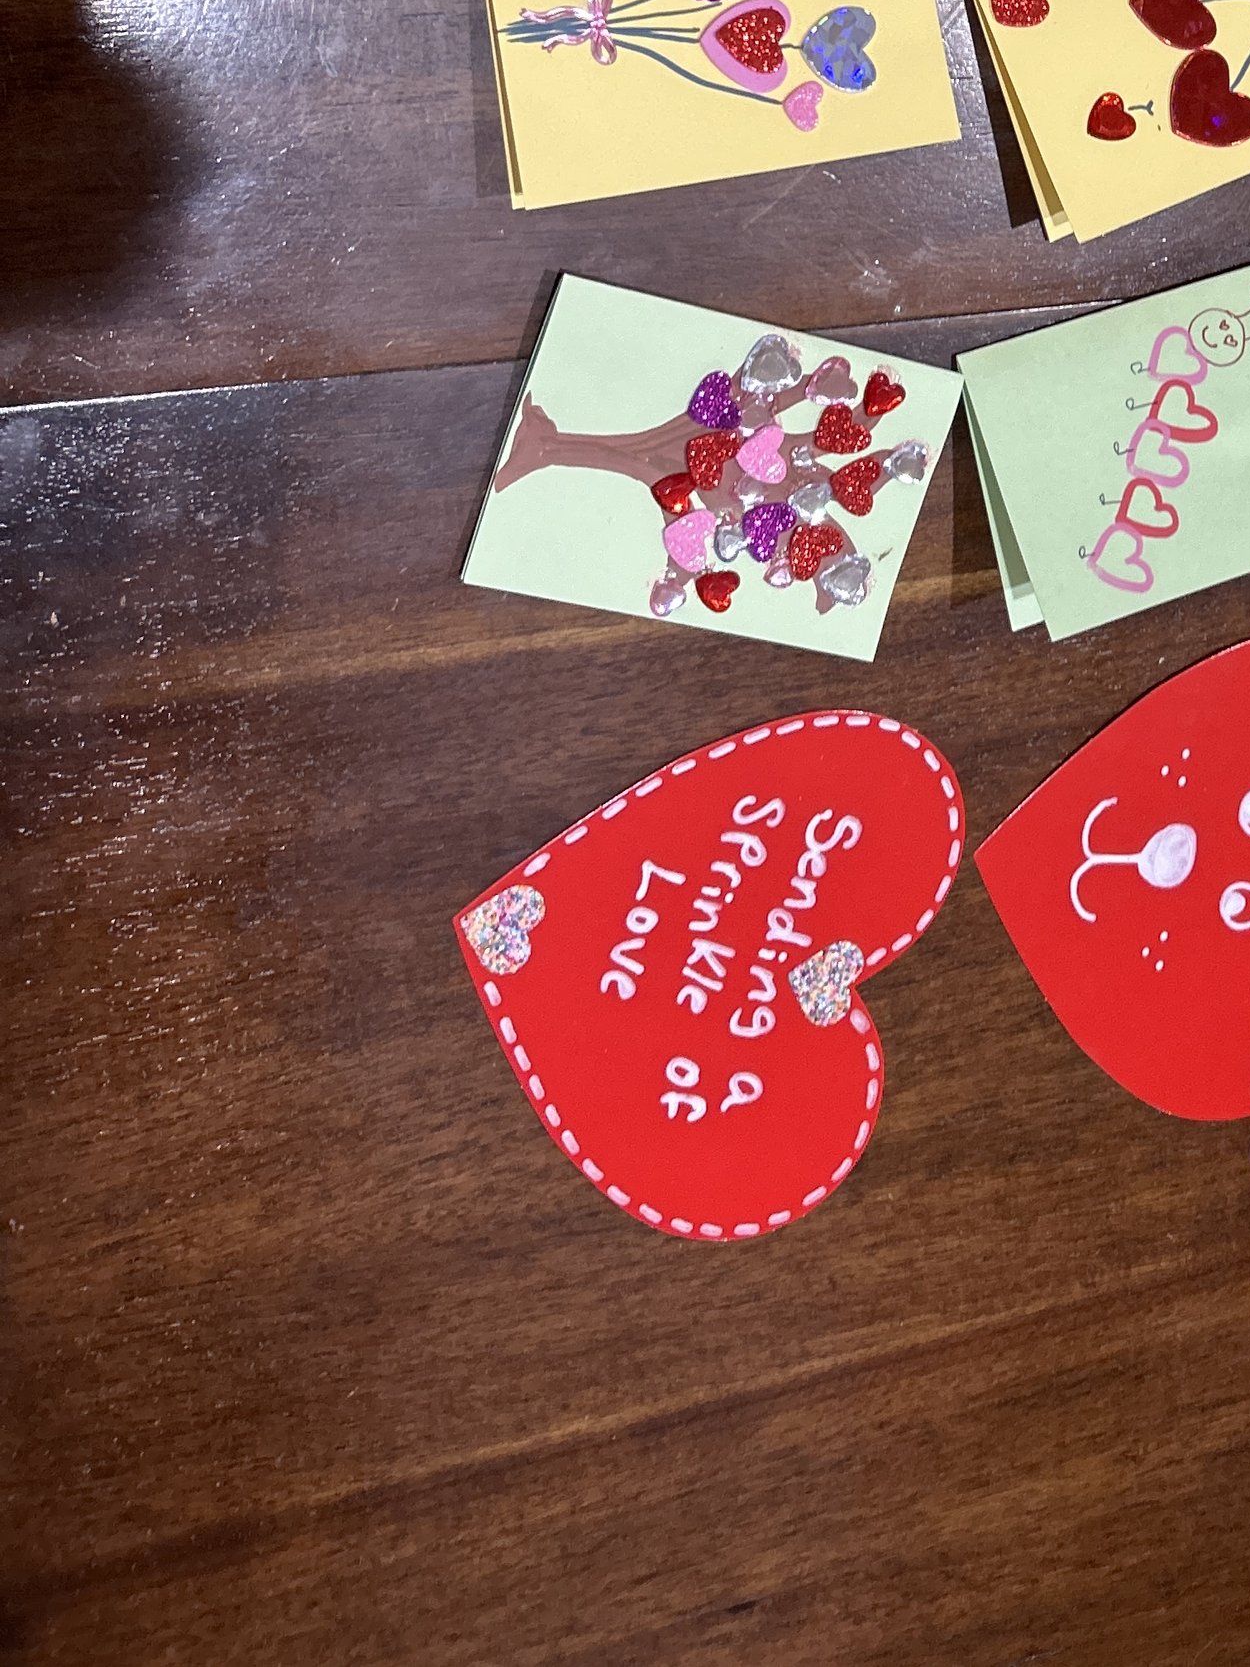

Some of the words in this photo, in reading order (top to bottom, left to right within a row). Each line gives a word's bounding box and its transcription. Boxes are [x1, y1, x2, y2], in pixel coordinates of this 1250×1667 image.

[600, 859, 688, 1001] Love
[729, 807, 864, 1039] Sending
[660, 1056, 707, 1123] of
[720, 1070, 763, 1114] a
